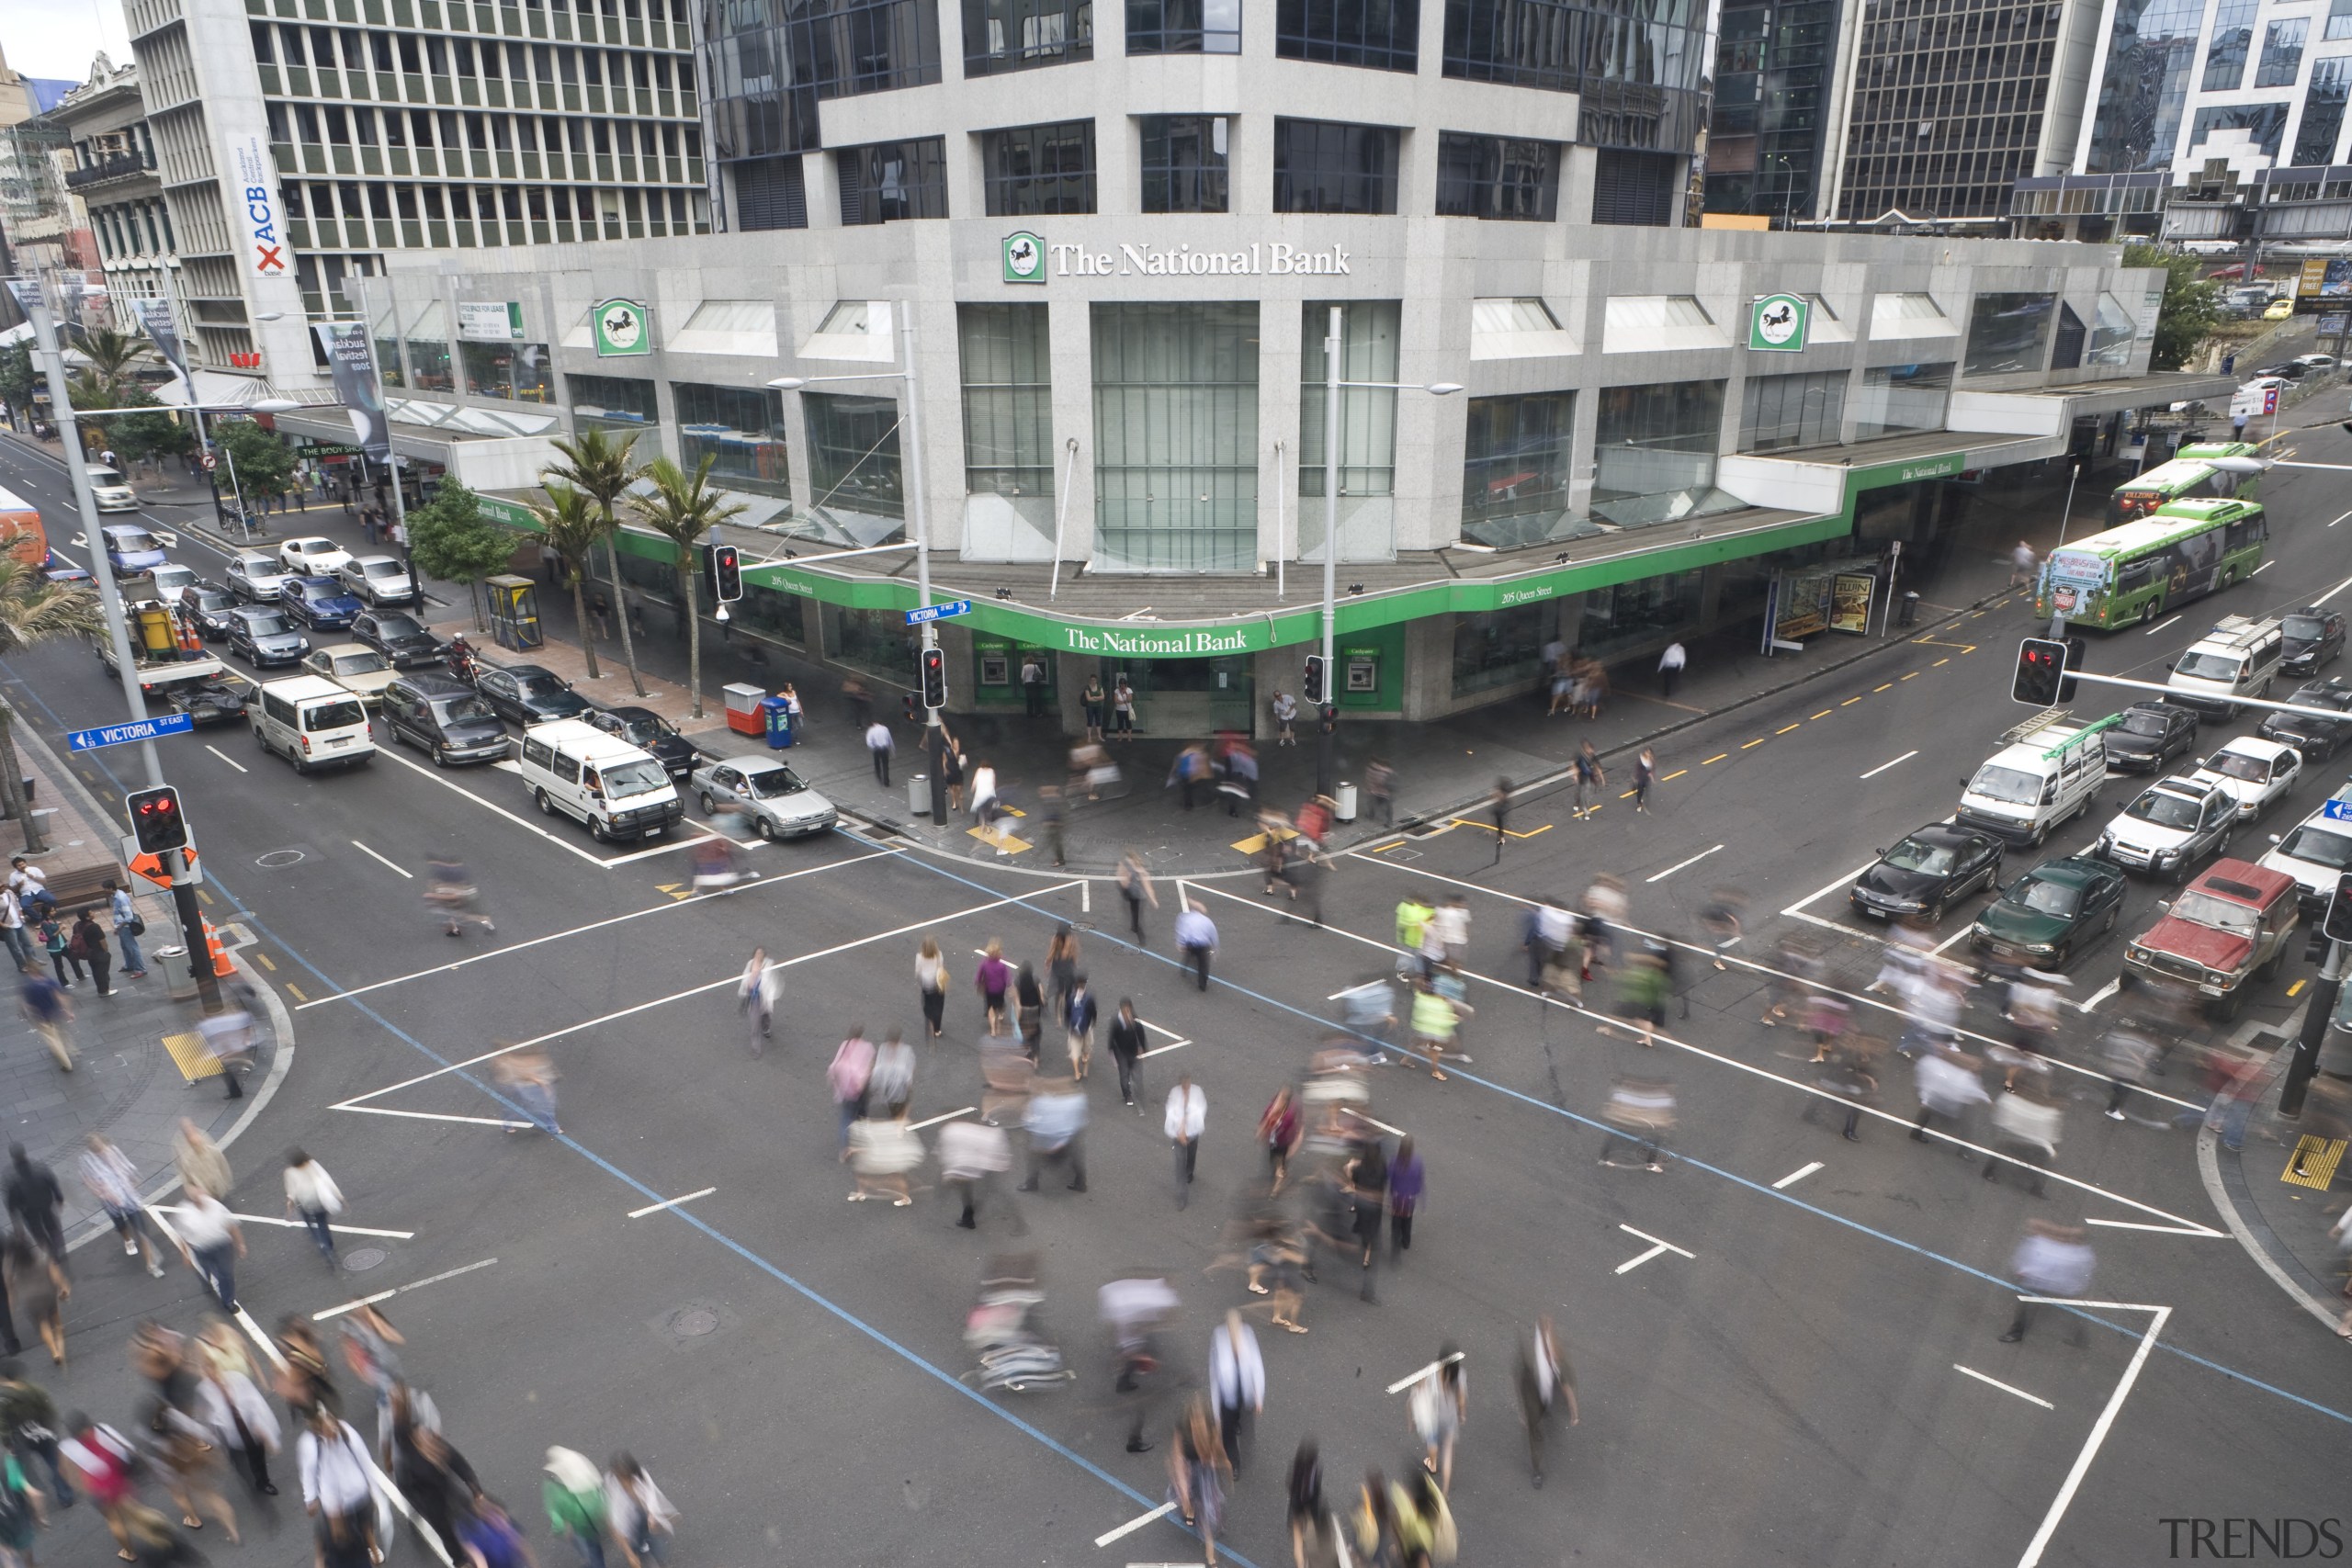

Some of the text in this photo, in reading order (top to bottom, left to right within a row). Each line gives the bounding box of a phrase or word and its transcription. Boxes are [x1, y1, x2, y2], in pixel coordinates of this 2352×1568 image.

[237, 147, 249, 183] Auckland
[247, 157, 256, 184] Central
[251, 137, 265, 184] Backpackers
[245, 186, 277, 244] ACB
[1050, 242, 1351, 276] The National Bank
[2302, 282, 2320, 290] FREE!
[302, 447, 320, 457] THE
[321, 446, 343, 455] BODY
[1902, 462, 1952, 480] The National Bank
[495, 506, 512, 522] Bank
[771, 575, 813, 594] 205 Queen Street
[1501, 586, 1553, 604] 205 Queen Street
[910, 608, 939, 622] VICTORIA
[1065, 627, 1248, 653] The National Bank
[101, 716, 184, 743] VICTORIA ST EAST
